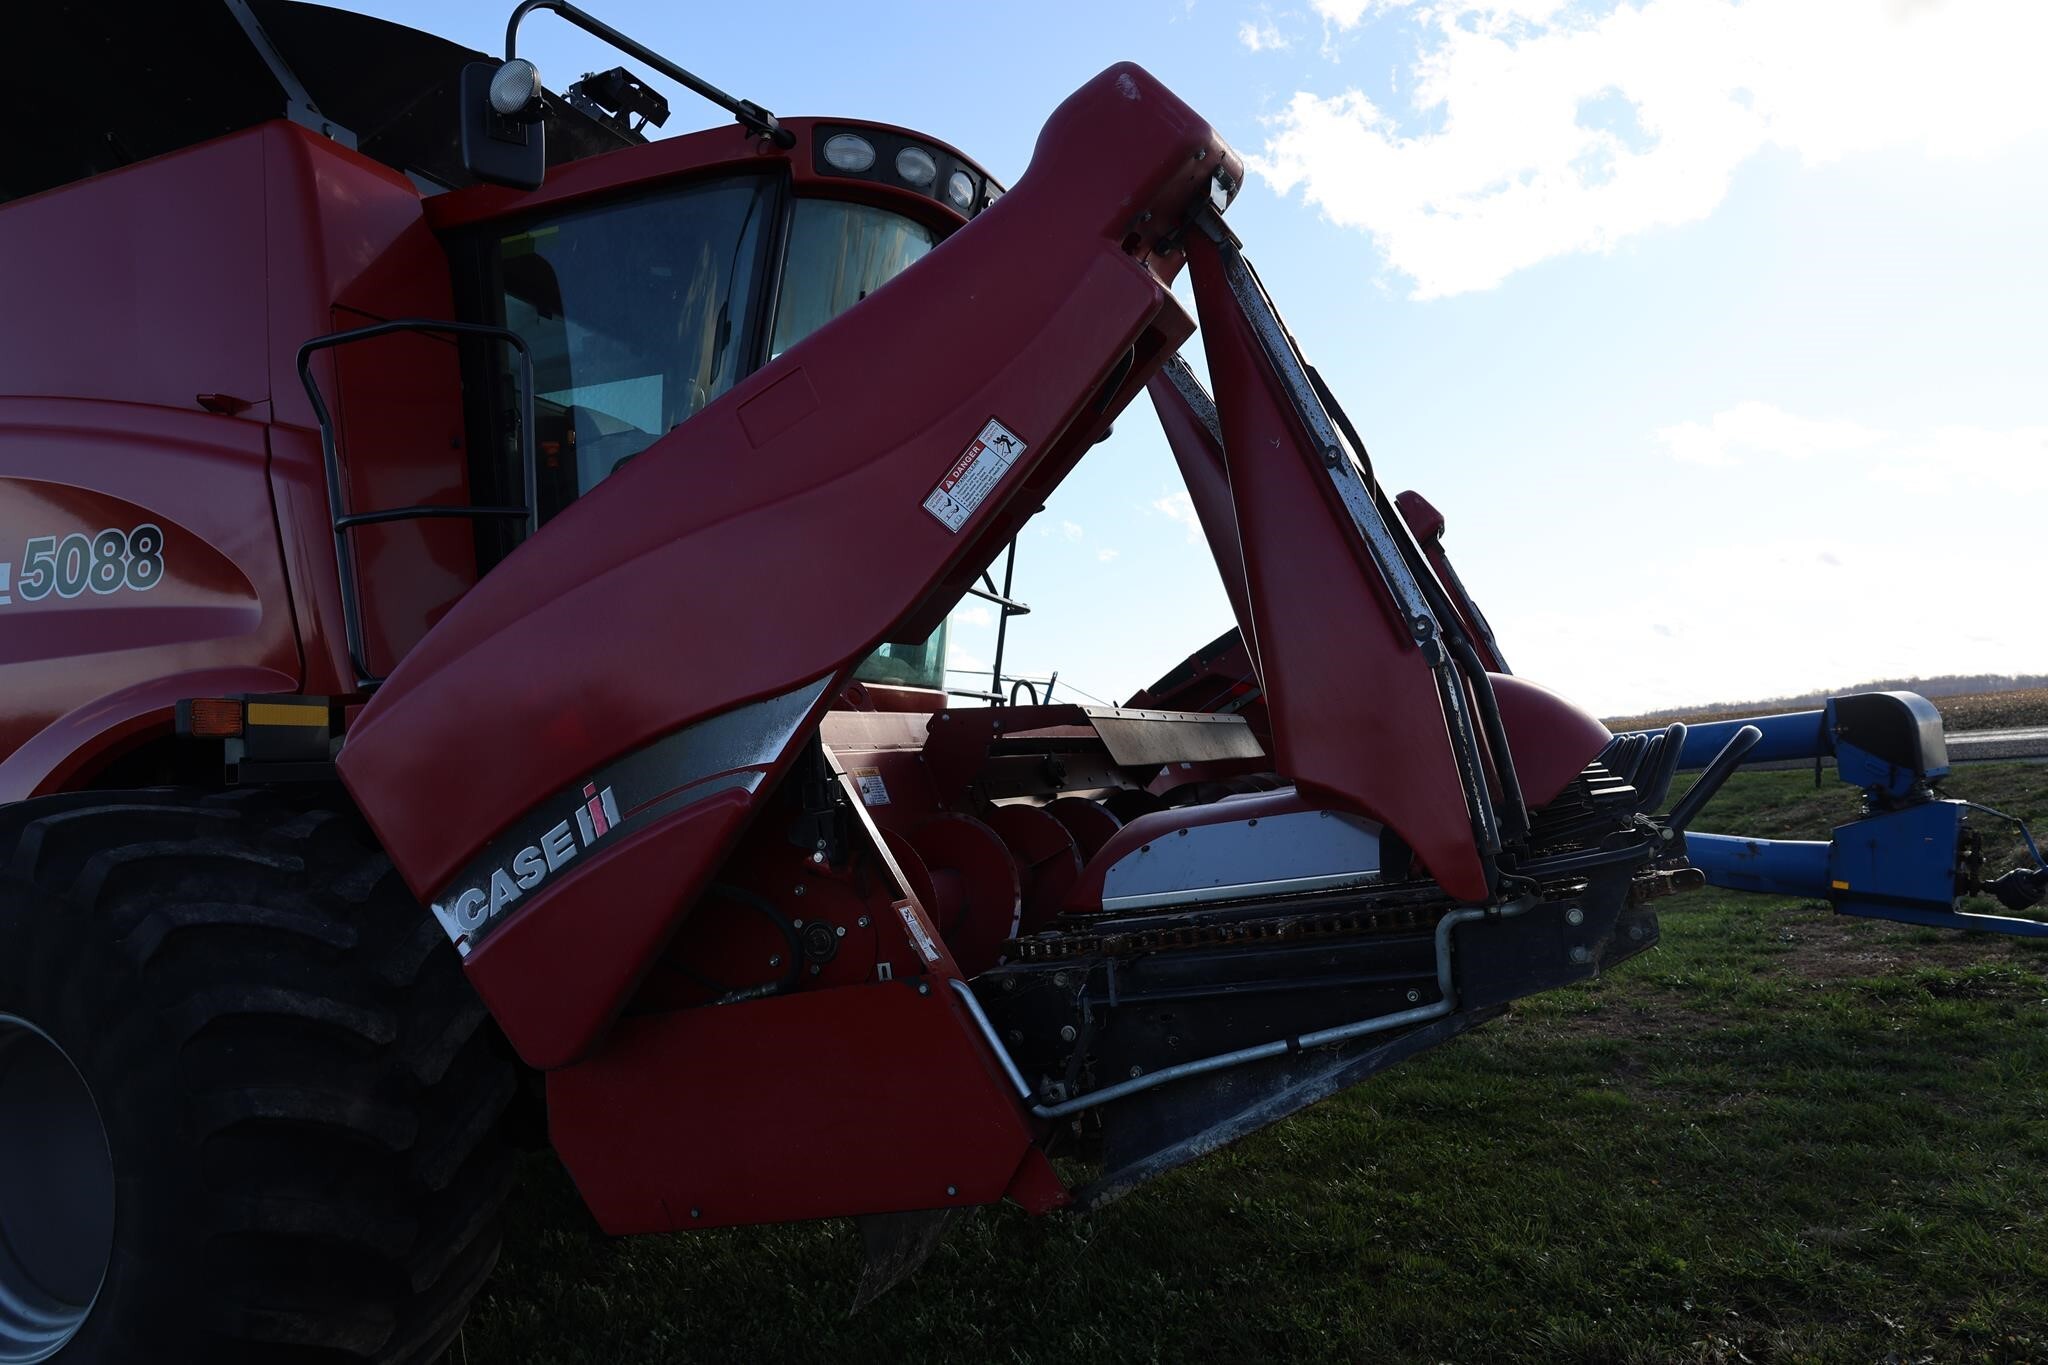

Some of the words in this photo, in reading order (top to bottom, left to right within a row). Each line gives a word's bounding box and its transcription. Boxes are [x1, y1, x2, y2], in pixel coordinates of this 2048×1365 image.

[951, 445, 980, 478] DANGER
[954, 472, 969, 488] STAND
[966, 458, 980, 474] CLEAR
[18, 523, 164, 601] 5088
[456, 819, 578, 930] CASE
